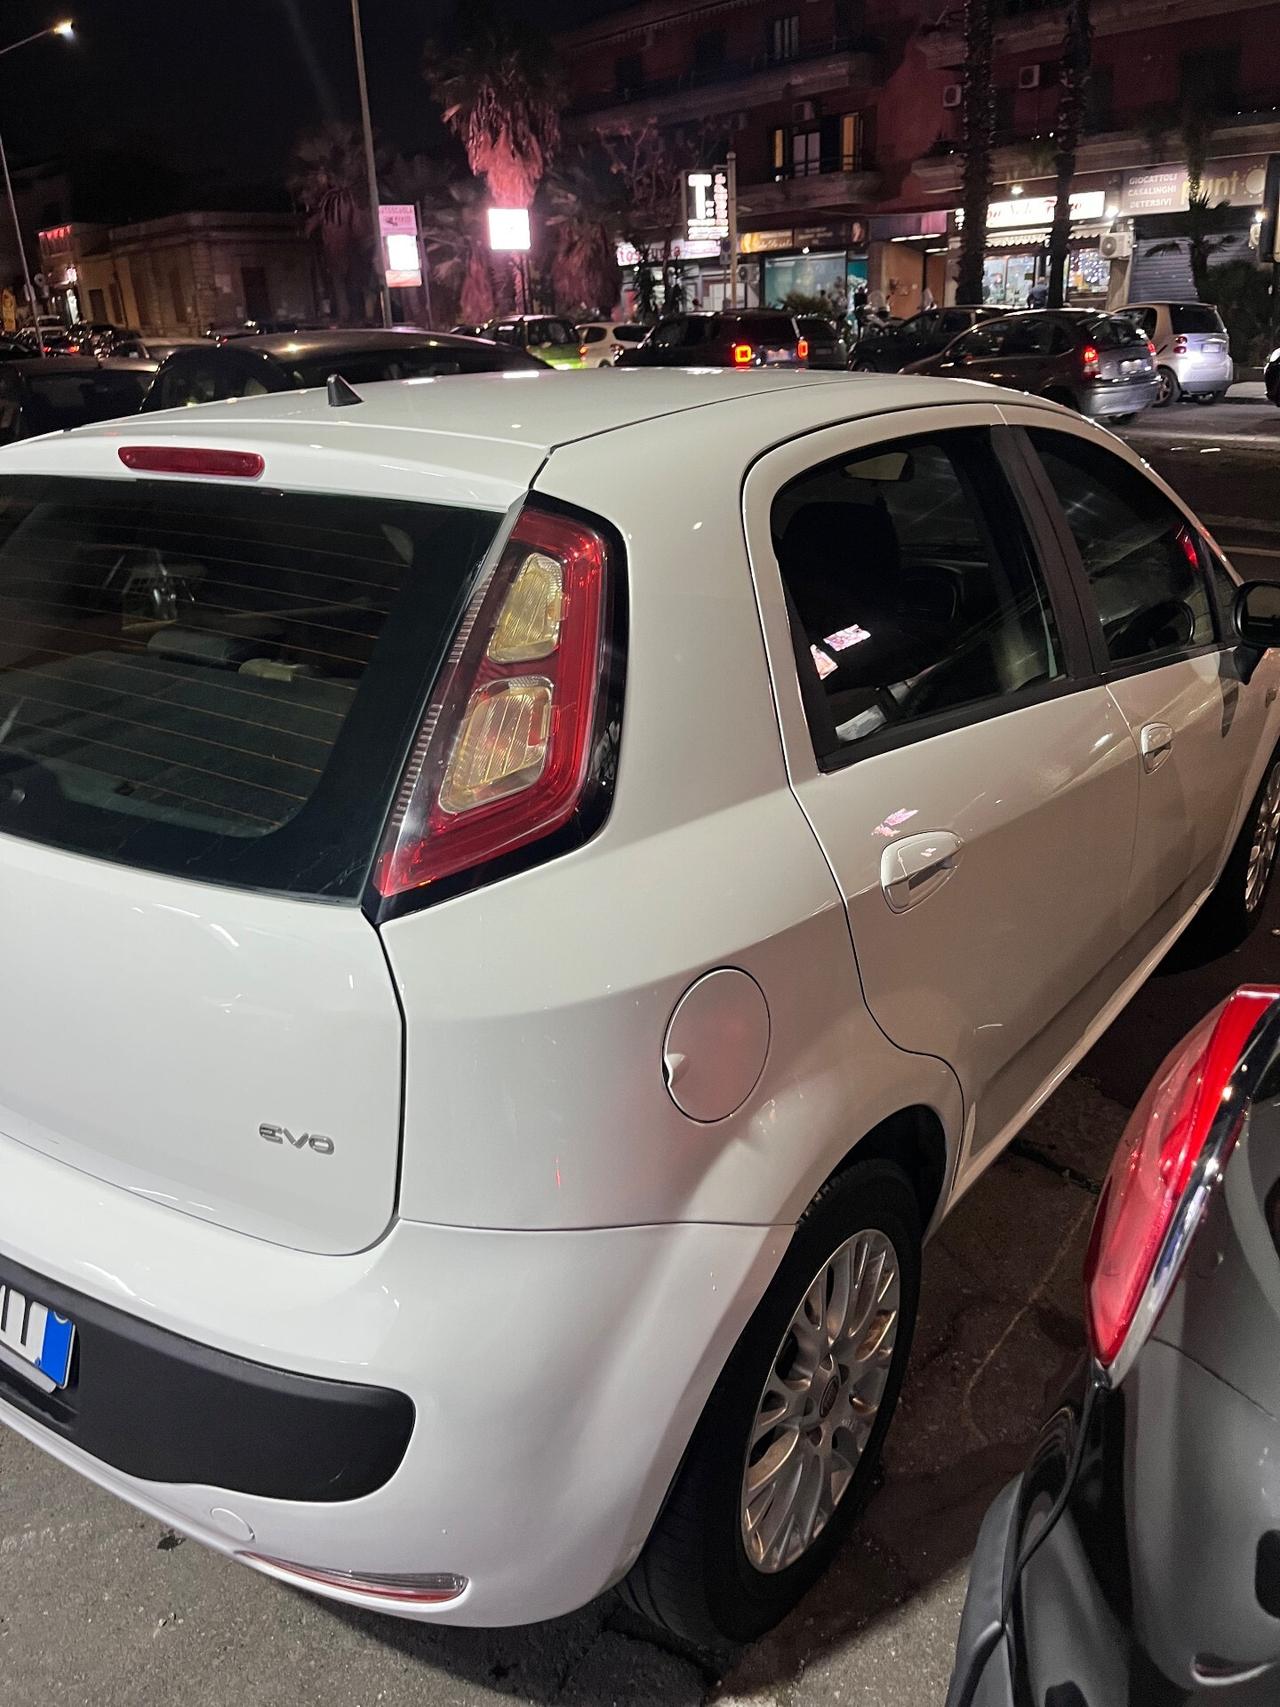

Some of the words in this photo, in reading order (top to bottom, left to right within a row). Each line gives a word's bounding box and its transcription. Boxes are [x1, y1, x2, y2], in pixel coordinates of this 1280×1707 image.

[1129, 174, 1176, 185] GIOCATTOLI
[1128, 186, 1176, 197] CASALINGHI
[1130, 199, 1171, 209] DETERSIVI
[259, 1123, 335, 1155] EVO
